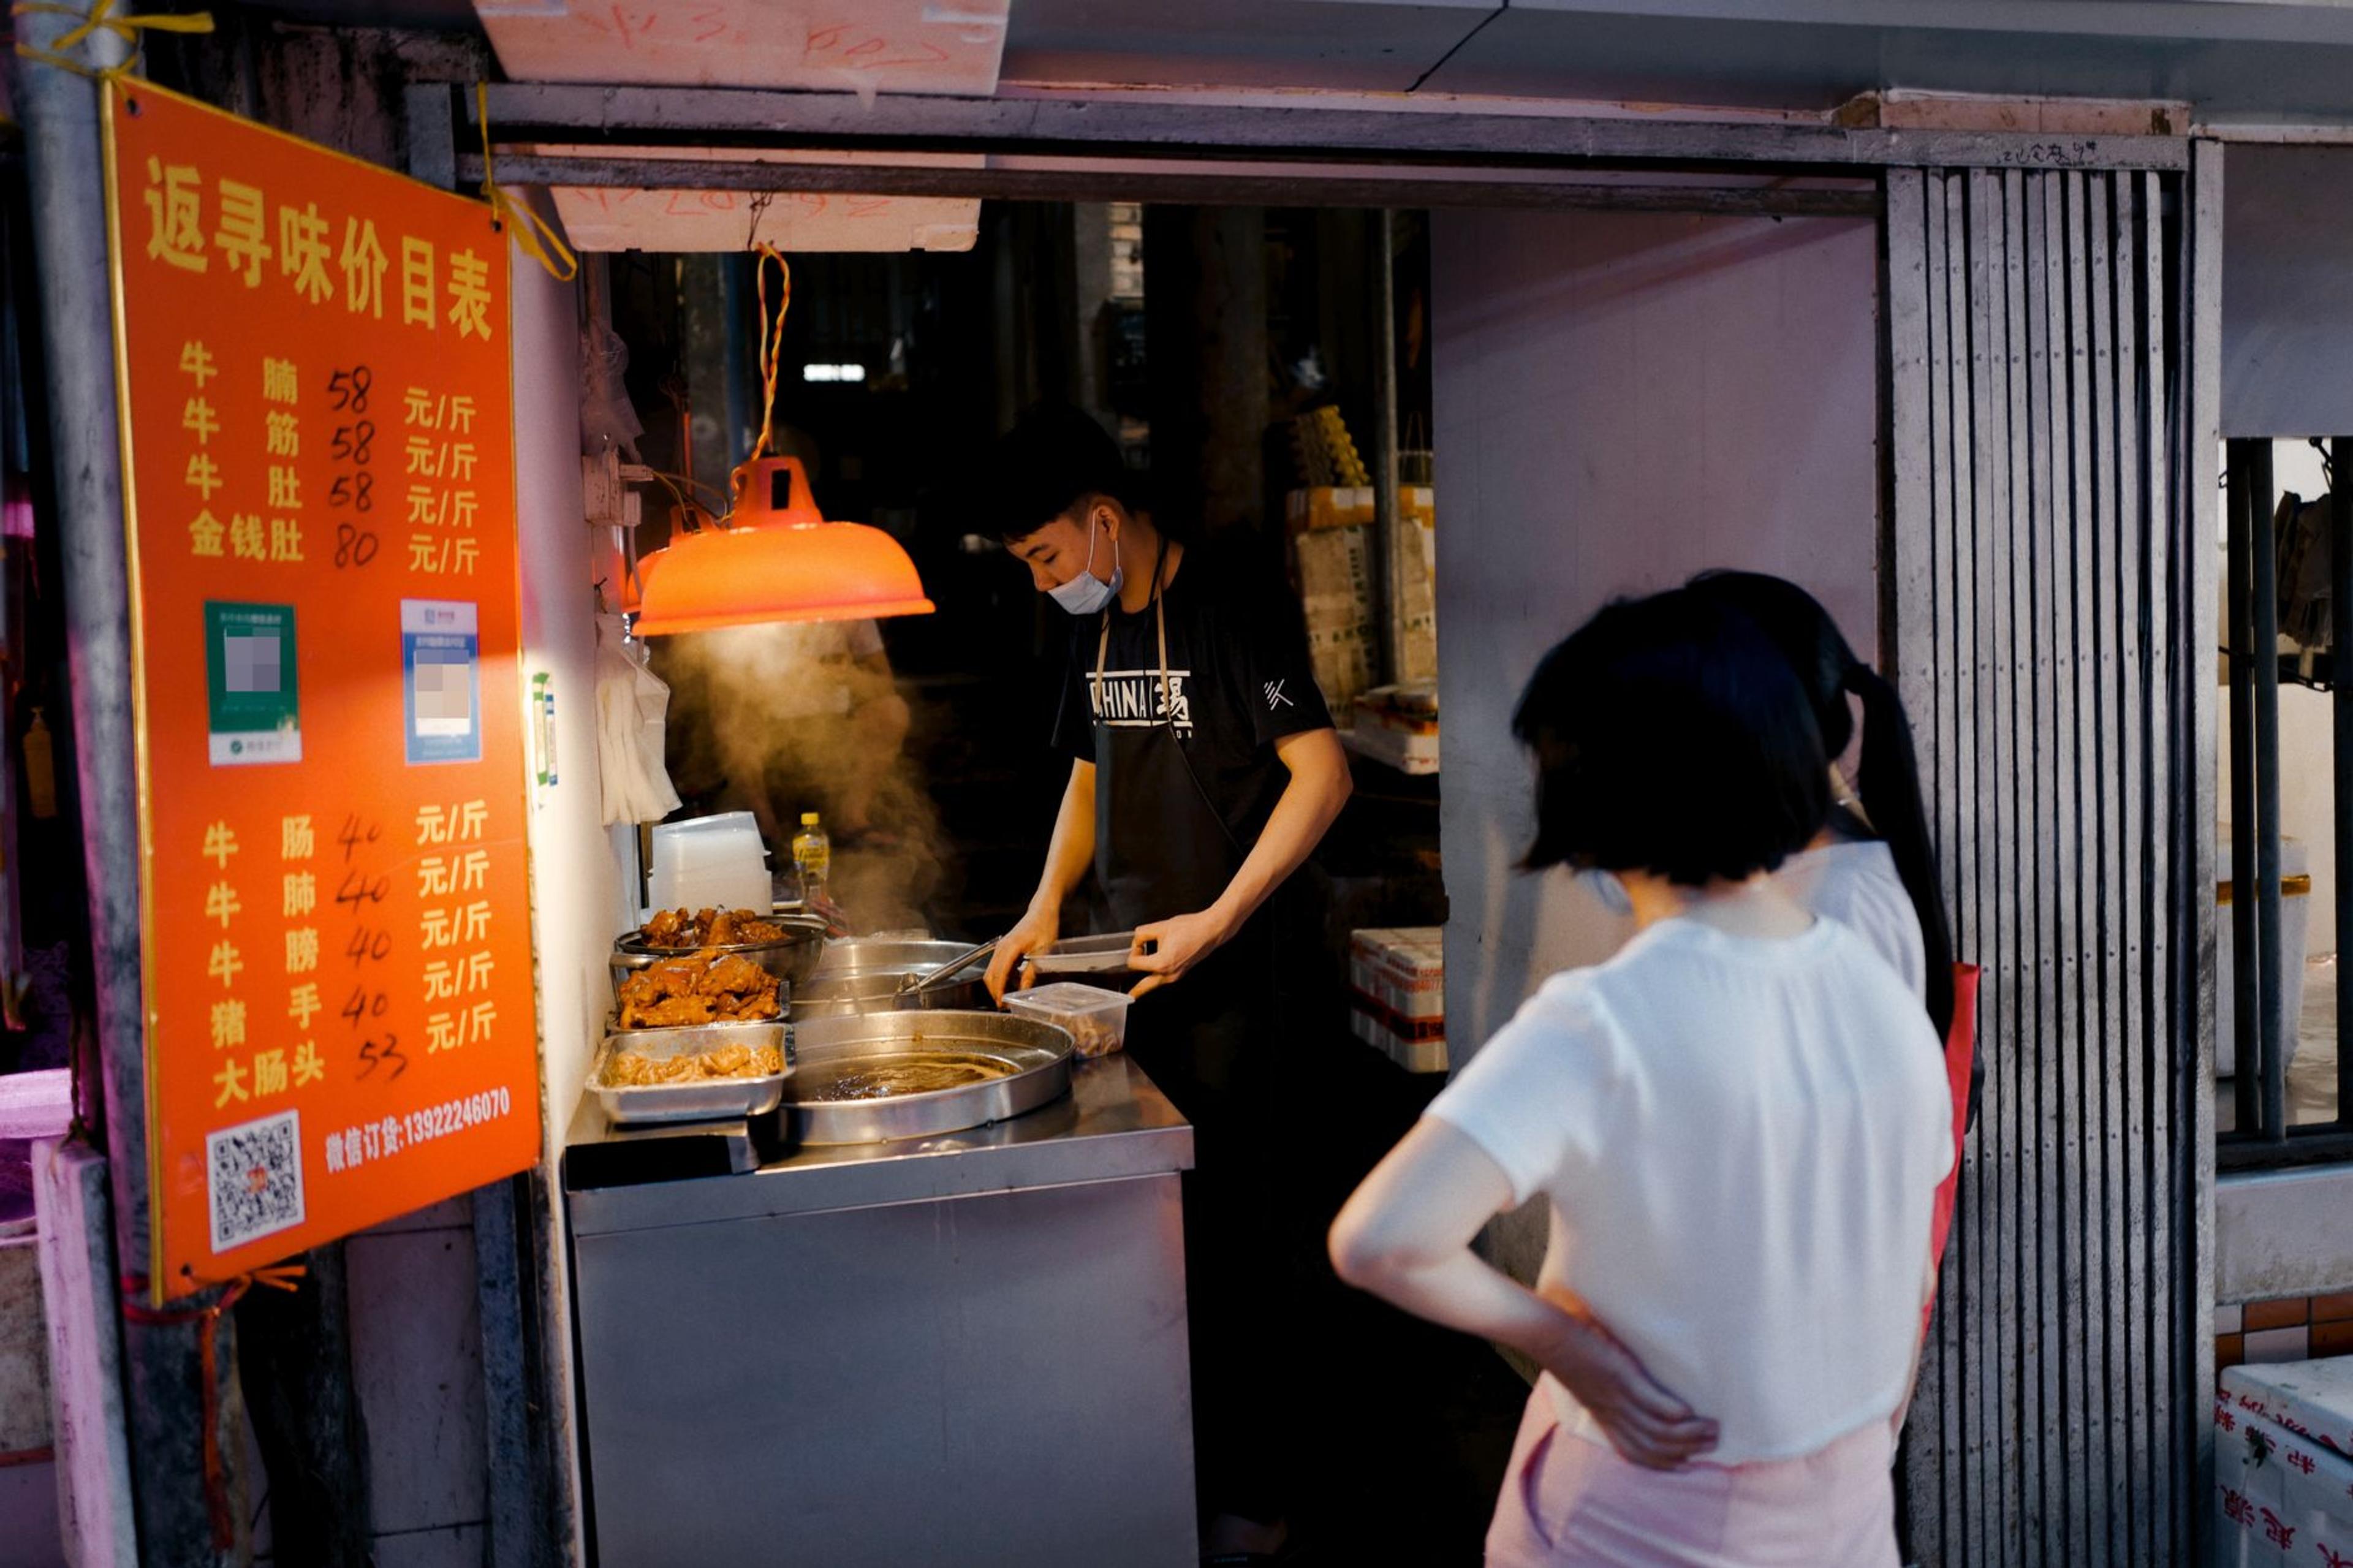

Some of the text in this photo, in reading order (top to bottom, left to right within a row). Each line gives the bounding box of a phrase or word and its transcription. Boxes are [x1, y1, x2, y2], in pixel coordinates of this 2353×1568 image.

[143, 155, 491, 341] 返寻味价目表
[181, 342, 476, 433] 牛 腩 58 元/斤
[183, 398, 477, 480] 牛 筋 58 元/斤
[186, 454, 478, 527] 牛 肚 58 元/斤
[189, 509, 480, 576] 金钱肚 80 元/斤
[204, 800, 488, 868] 牛 肠 40 元/斤
[207, 850, 489, 927] 牛 肺 40 元/斤
[210, 901, 491, 987] 牛 膀 40 元/斤
[211, 951, 494, 1050] 猪 手 40 元/斤
[214, 1001, 498, 1110] 大肠头 53 元/斤
[326, 1086, 510, 1173] 微信订货:13922246070
